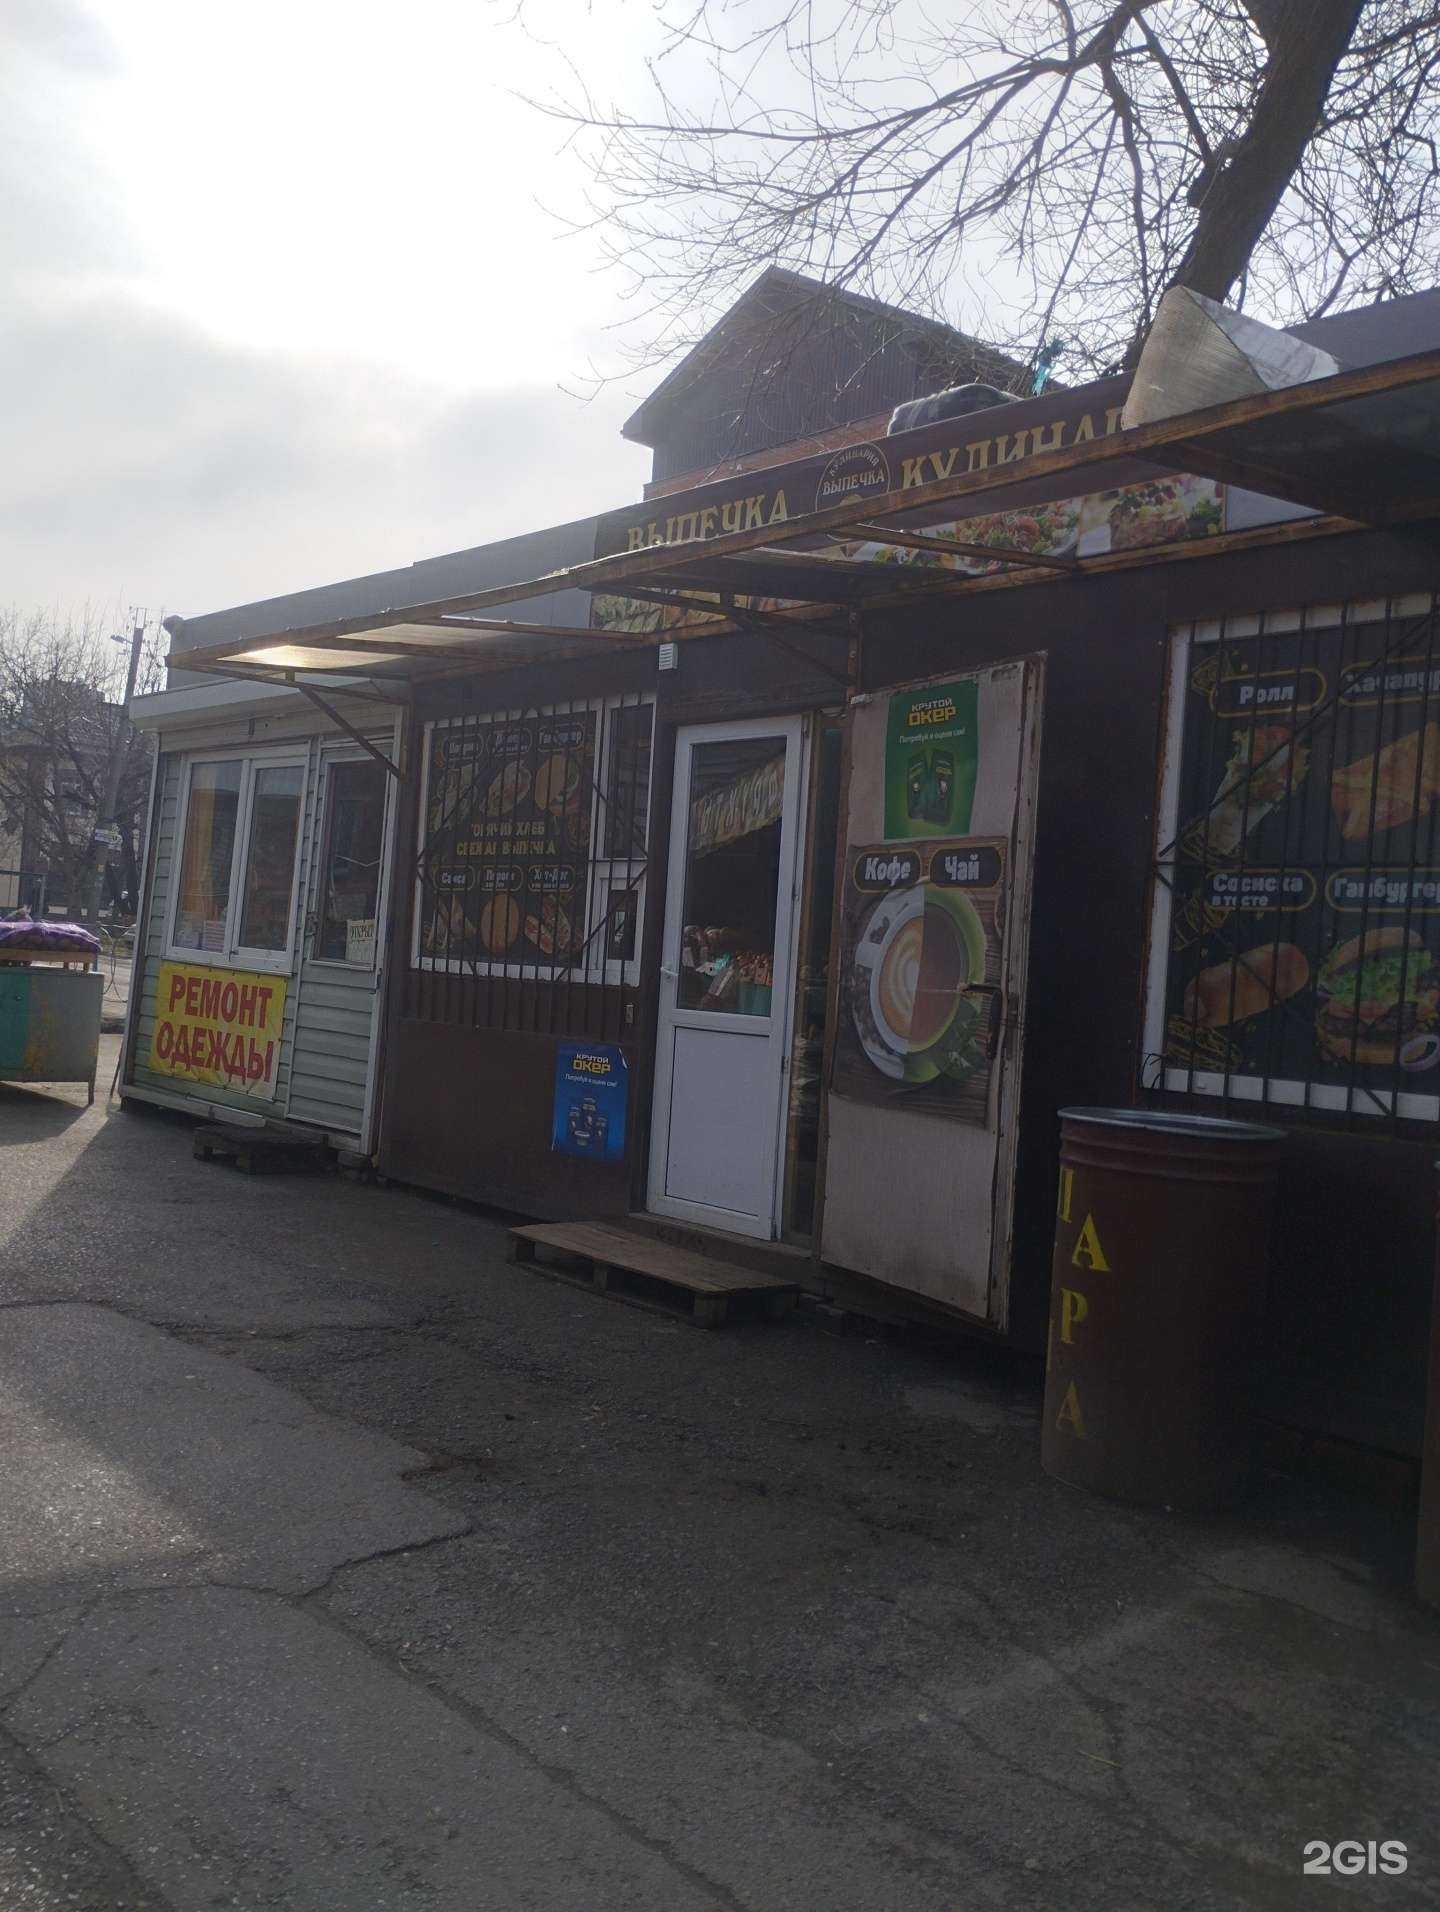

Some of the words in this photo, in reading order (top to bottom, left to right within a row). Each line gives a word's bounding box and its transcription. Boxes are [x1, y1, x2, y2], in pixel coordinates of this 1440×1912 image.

[822, 469, 885, 496] ВЫПЕЧКА
[627, 489, 789, 551] ВЫПЕЧКА
[912, 697, 953, 712] КРУТОЙ
[864, 855, 911, 886] Кофе
[945, 854, 979, 881] Чай
[168, 975, 273, 1029] РЕМОНТ
[156, 1021, 274, 1085] ОДЕЖДЫ
